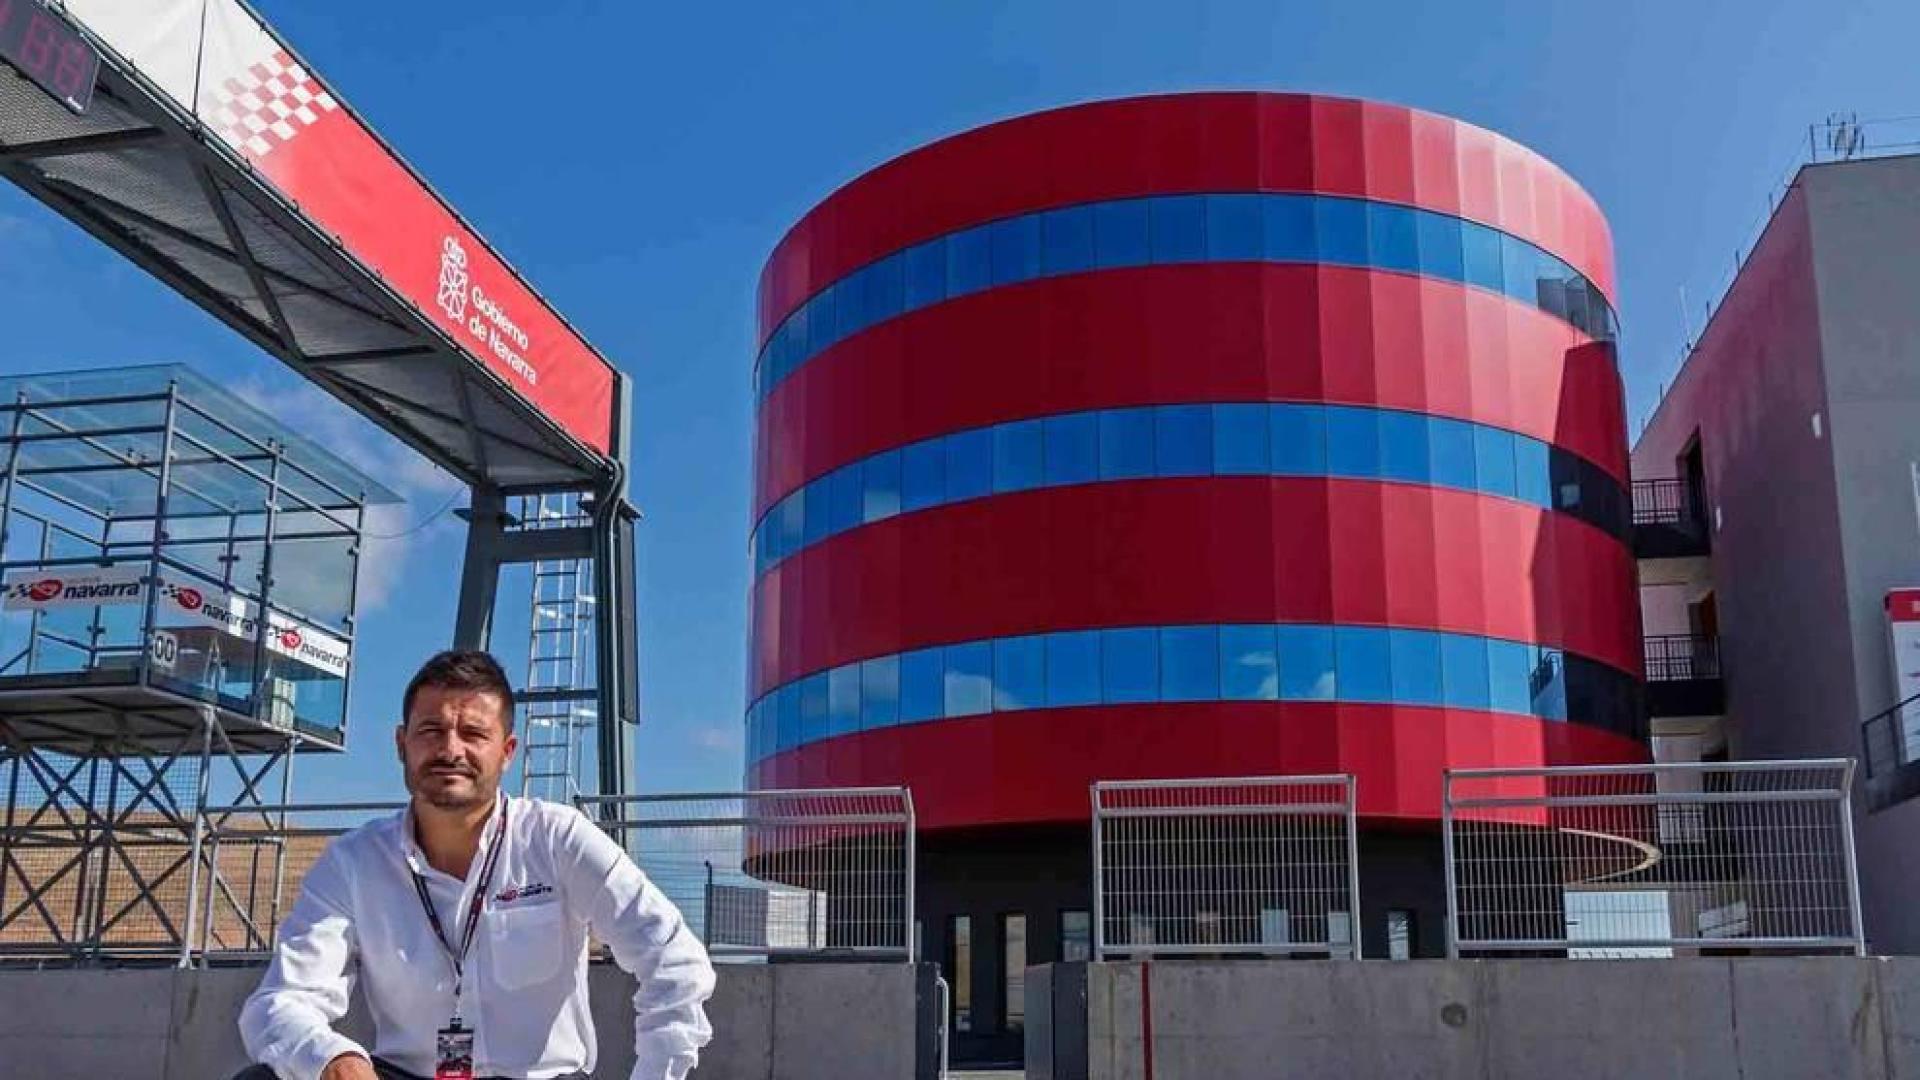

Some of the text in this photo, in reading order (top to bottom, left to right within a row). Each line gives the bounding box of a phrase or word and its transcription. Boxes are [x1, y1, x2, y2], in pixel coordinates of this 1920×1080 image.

[472, 286, 529, 350] Gobierno
[468, 314, 536, 385] de Navarra
[64, 583, 139, 599] navarra
[202, 603, 253, 632] navarra
[301, 643, 347, 667] navarra
